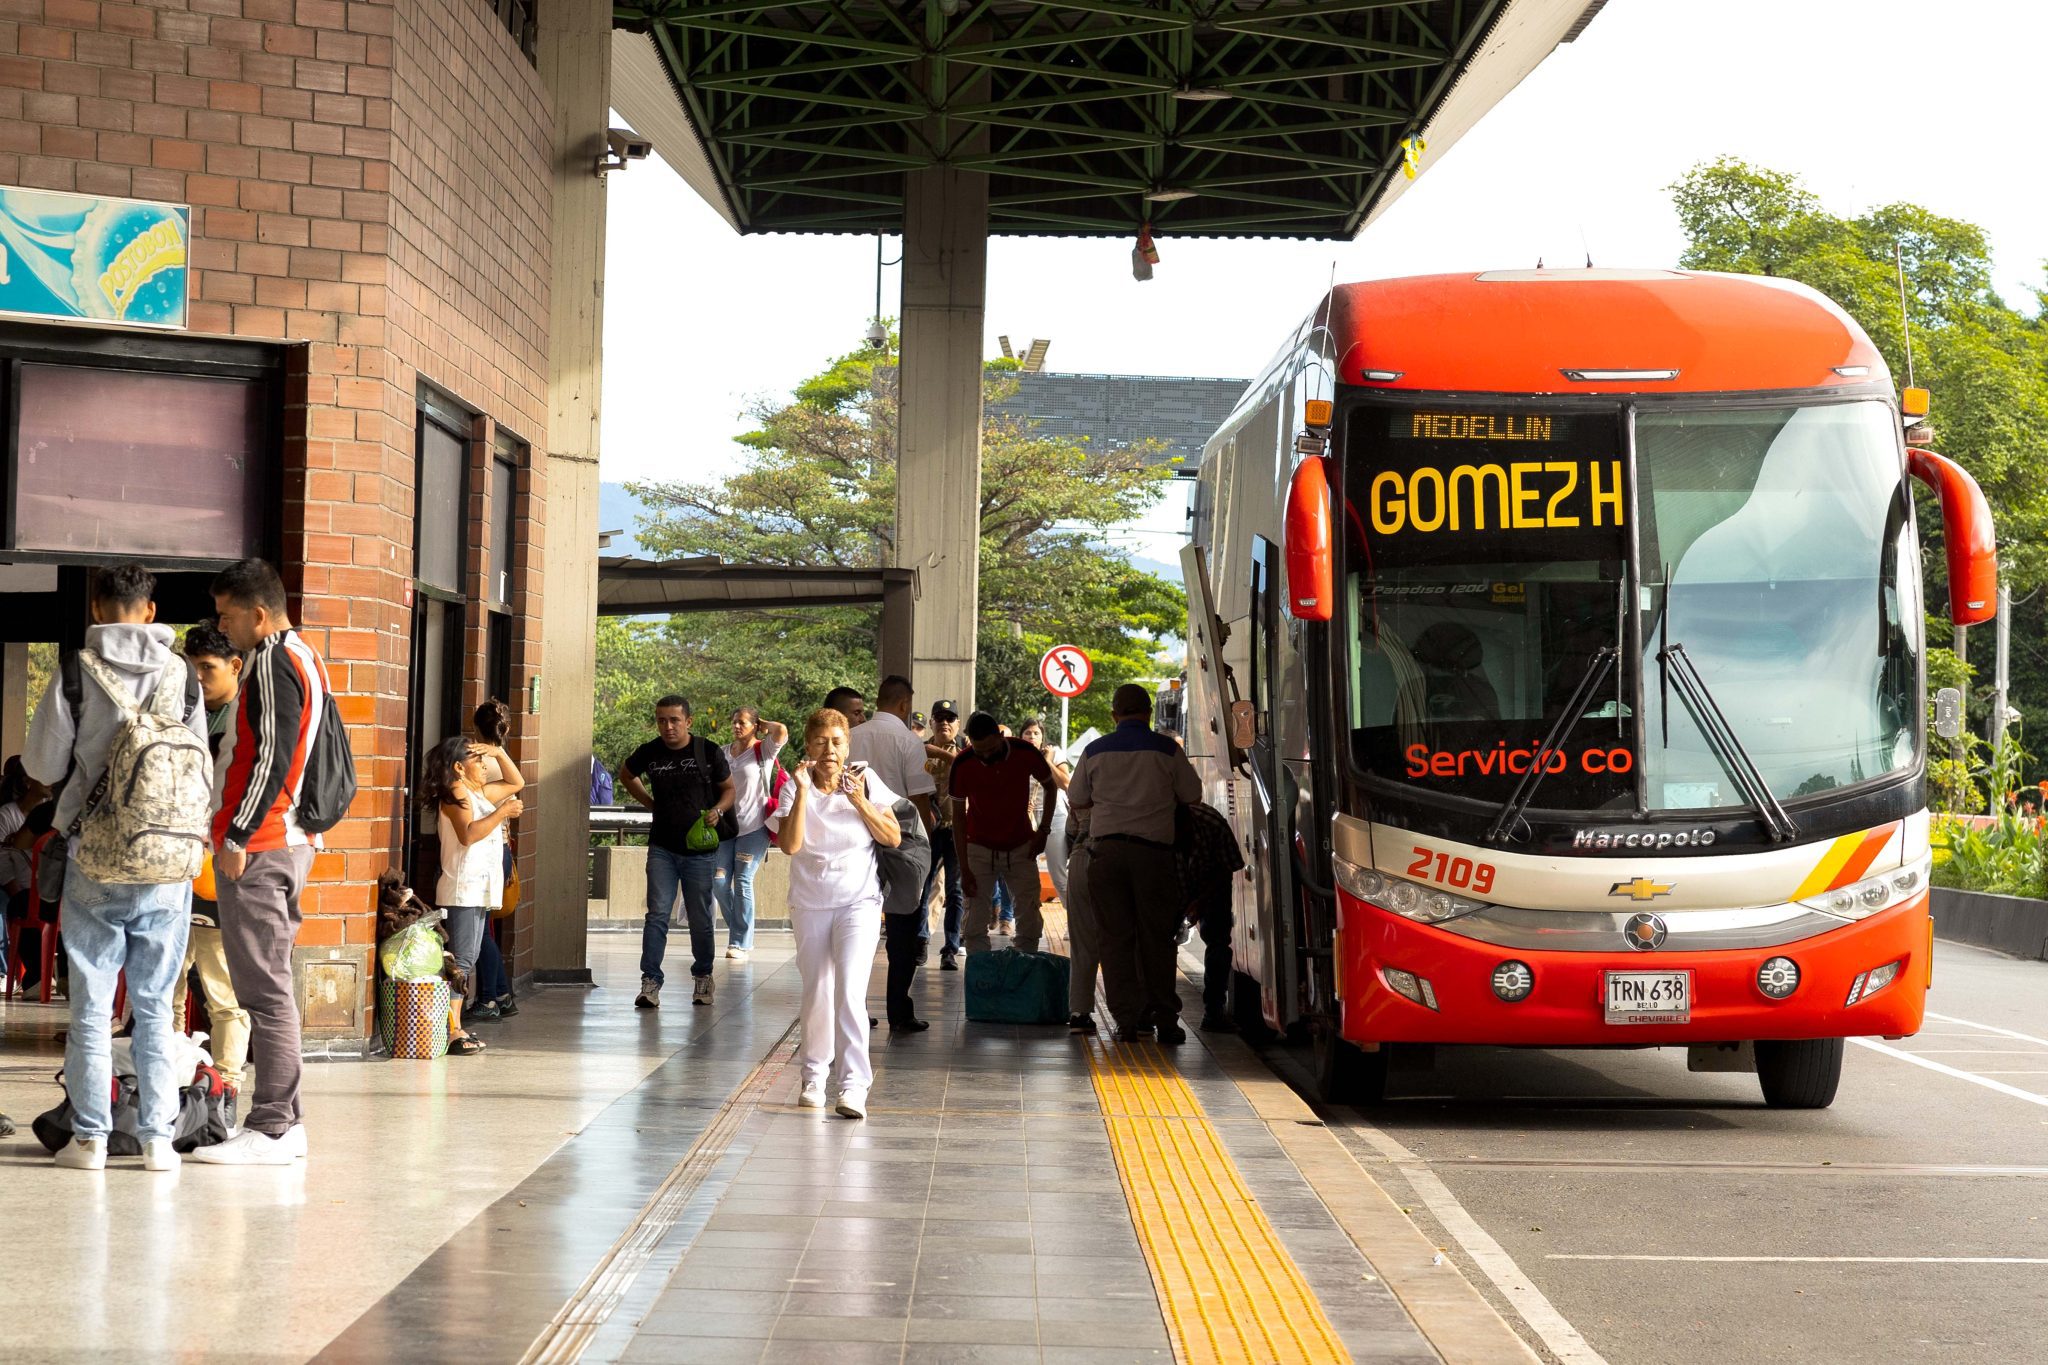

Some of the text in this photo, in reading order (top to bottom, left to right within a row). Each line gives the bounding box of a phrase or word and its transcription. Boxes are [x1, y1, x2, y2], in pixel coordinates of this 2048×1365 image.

[1413, 414, 1551, 440] MEDELLIN
[1370, 460, 1624, 535] GOMEZ H
[1372, 585, 1446, 595] Paradiso
[1492, 582, 1525, 594] Gel
[1405, 740, 1633, 778] Servicio co
[1572, 829, 1716, 850] Marcopolo
[1406, 846, 1496, 895] 2109
[1610, 980, 1684, 1001] TRN 638
